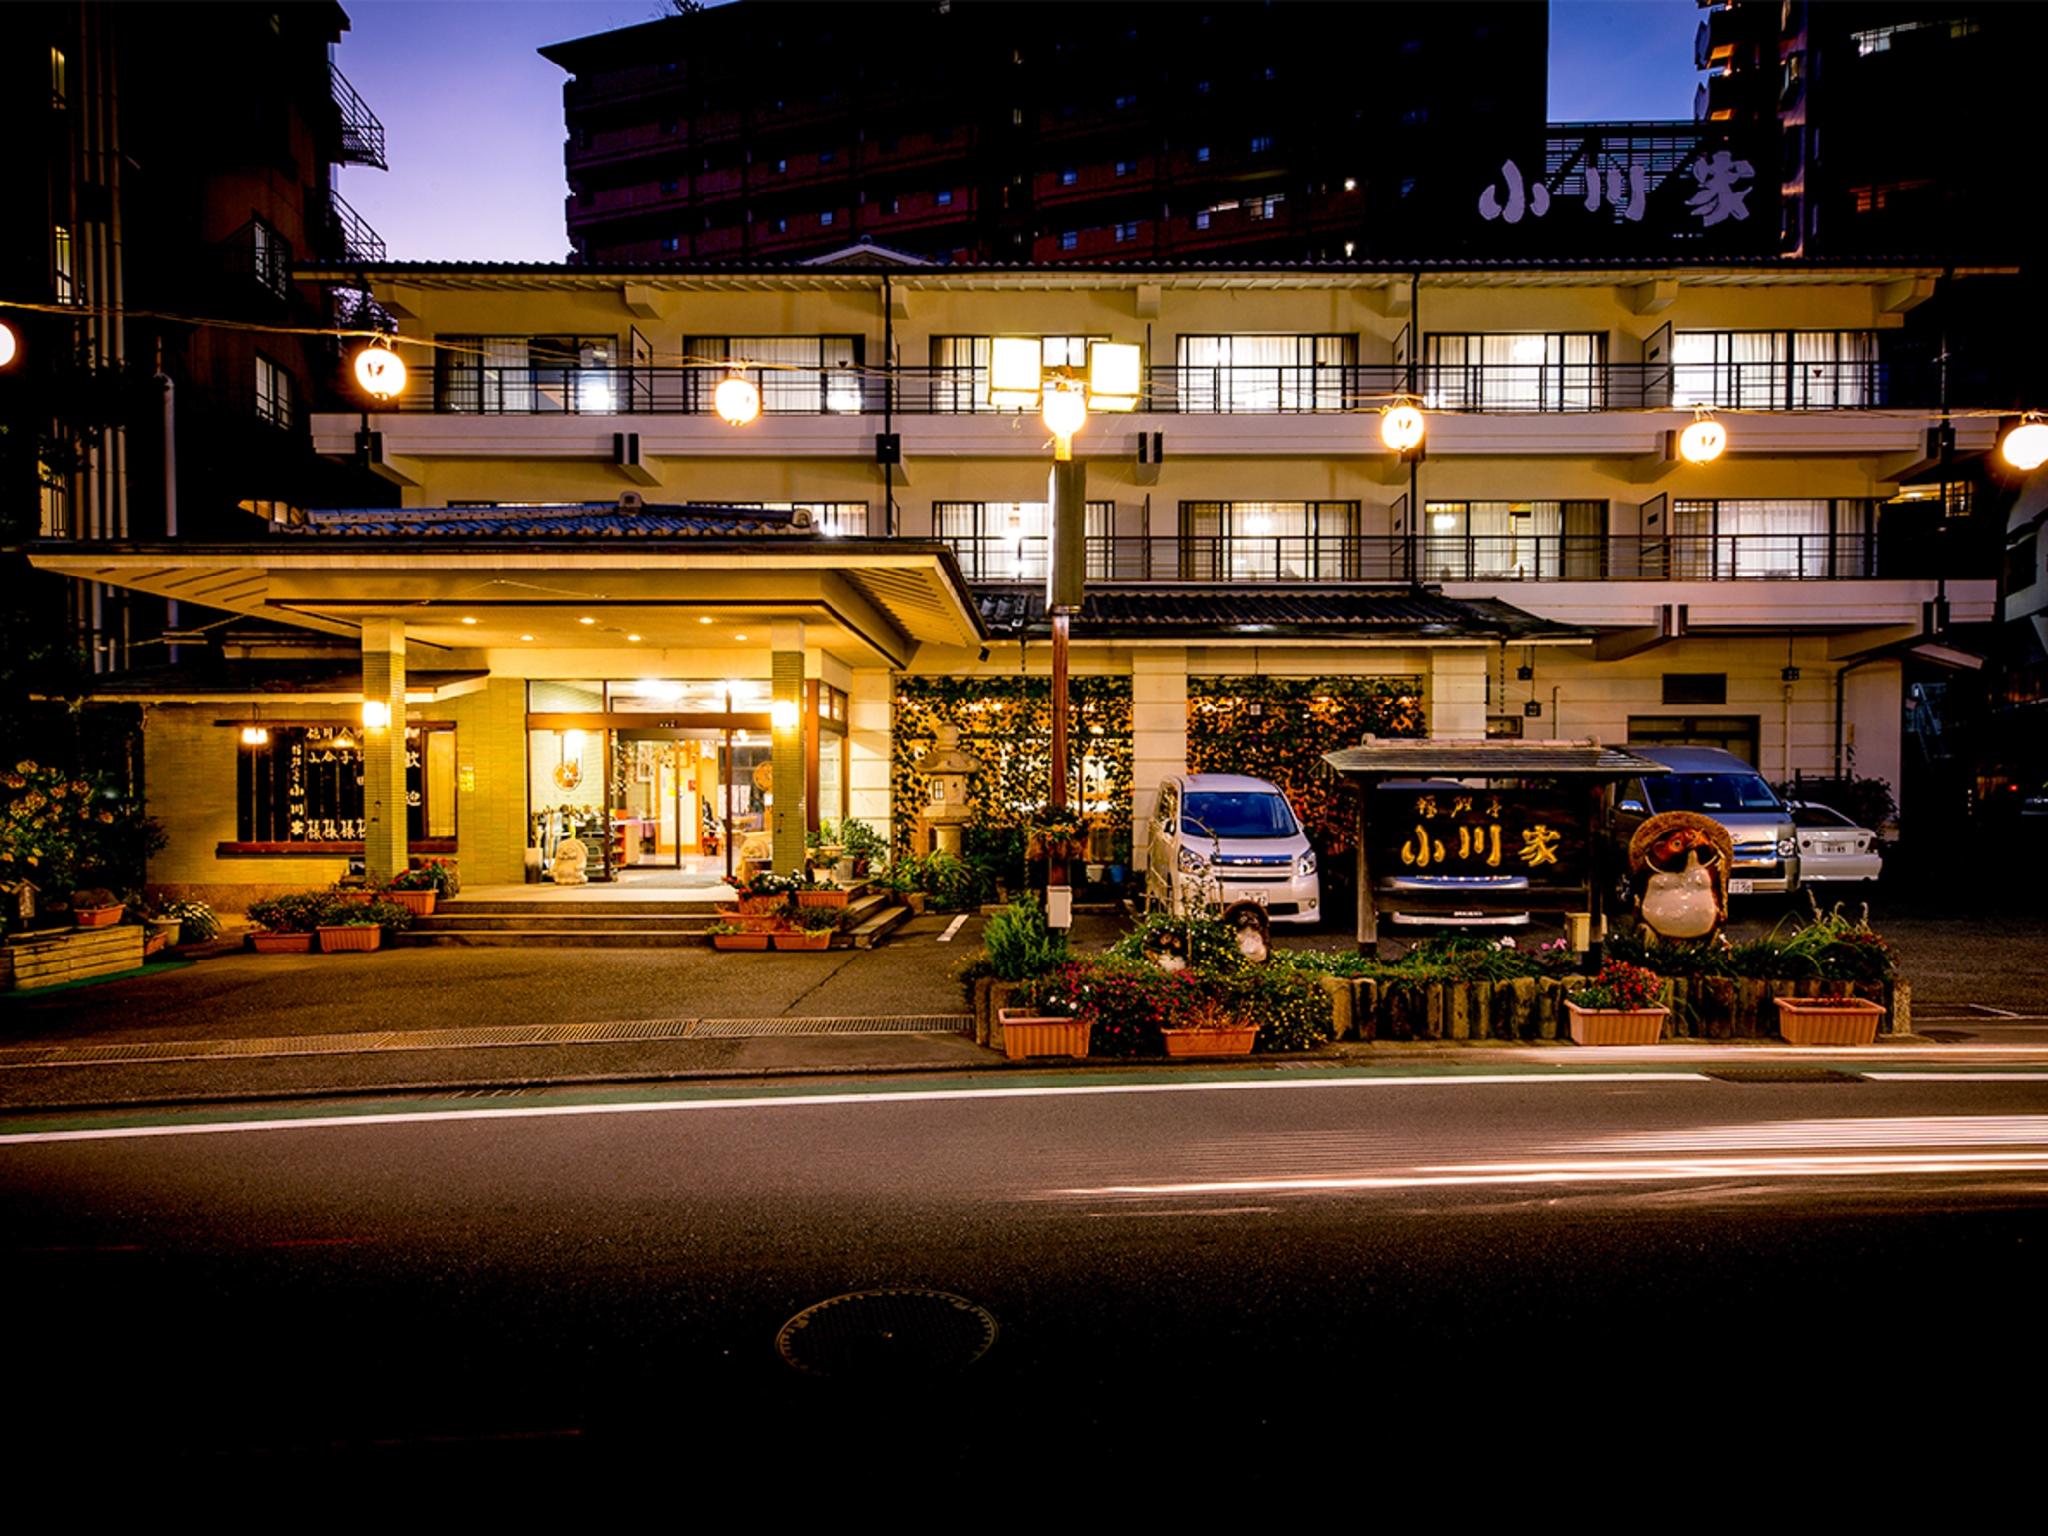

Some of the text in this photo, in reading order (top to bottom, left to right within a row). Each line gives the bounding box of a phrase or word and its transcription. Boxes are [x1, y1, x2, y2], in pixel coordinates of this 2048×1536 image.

[1478, 150, 1756, 228] 小川家
[1401, 823, 1562, 868] 小川家
